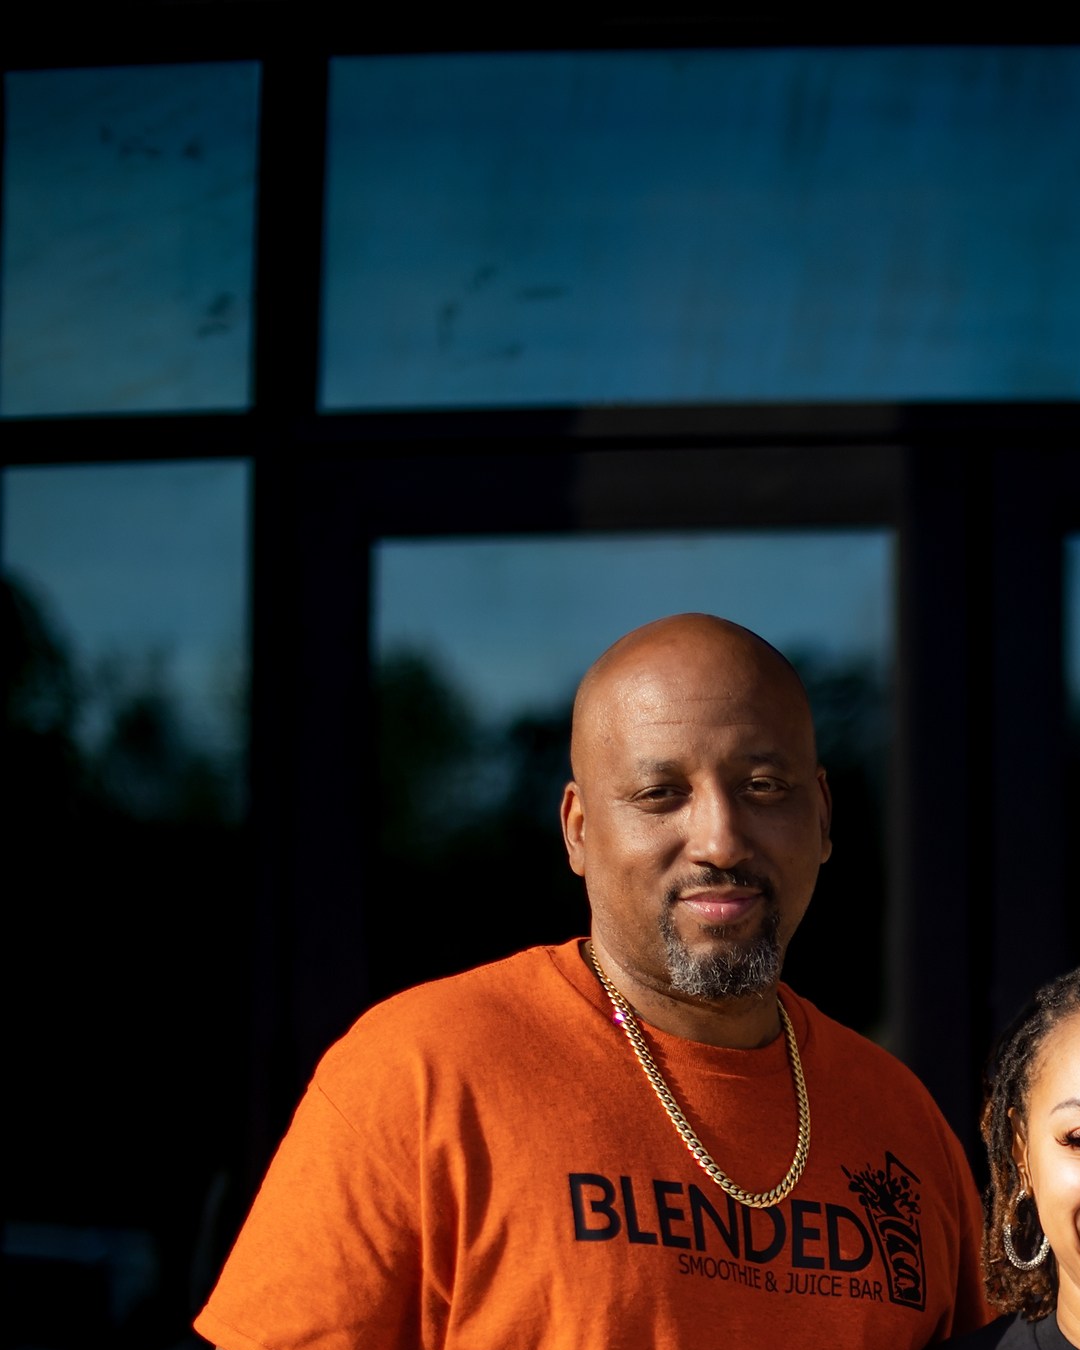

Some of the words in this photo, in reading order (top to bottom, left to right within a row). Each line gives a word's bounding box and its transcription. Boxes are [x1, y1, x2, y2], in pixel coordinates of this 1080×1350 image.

[569, 1173, 874, 1272] BLENDED
[679, 1255, 761, 1288] SMOOTHIE
[765, 1275, 779, 1293] &
[785, 1272, 842, 1297] JUICE
[849, 1278, 884, 1302] BAR
